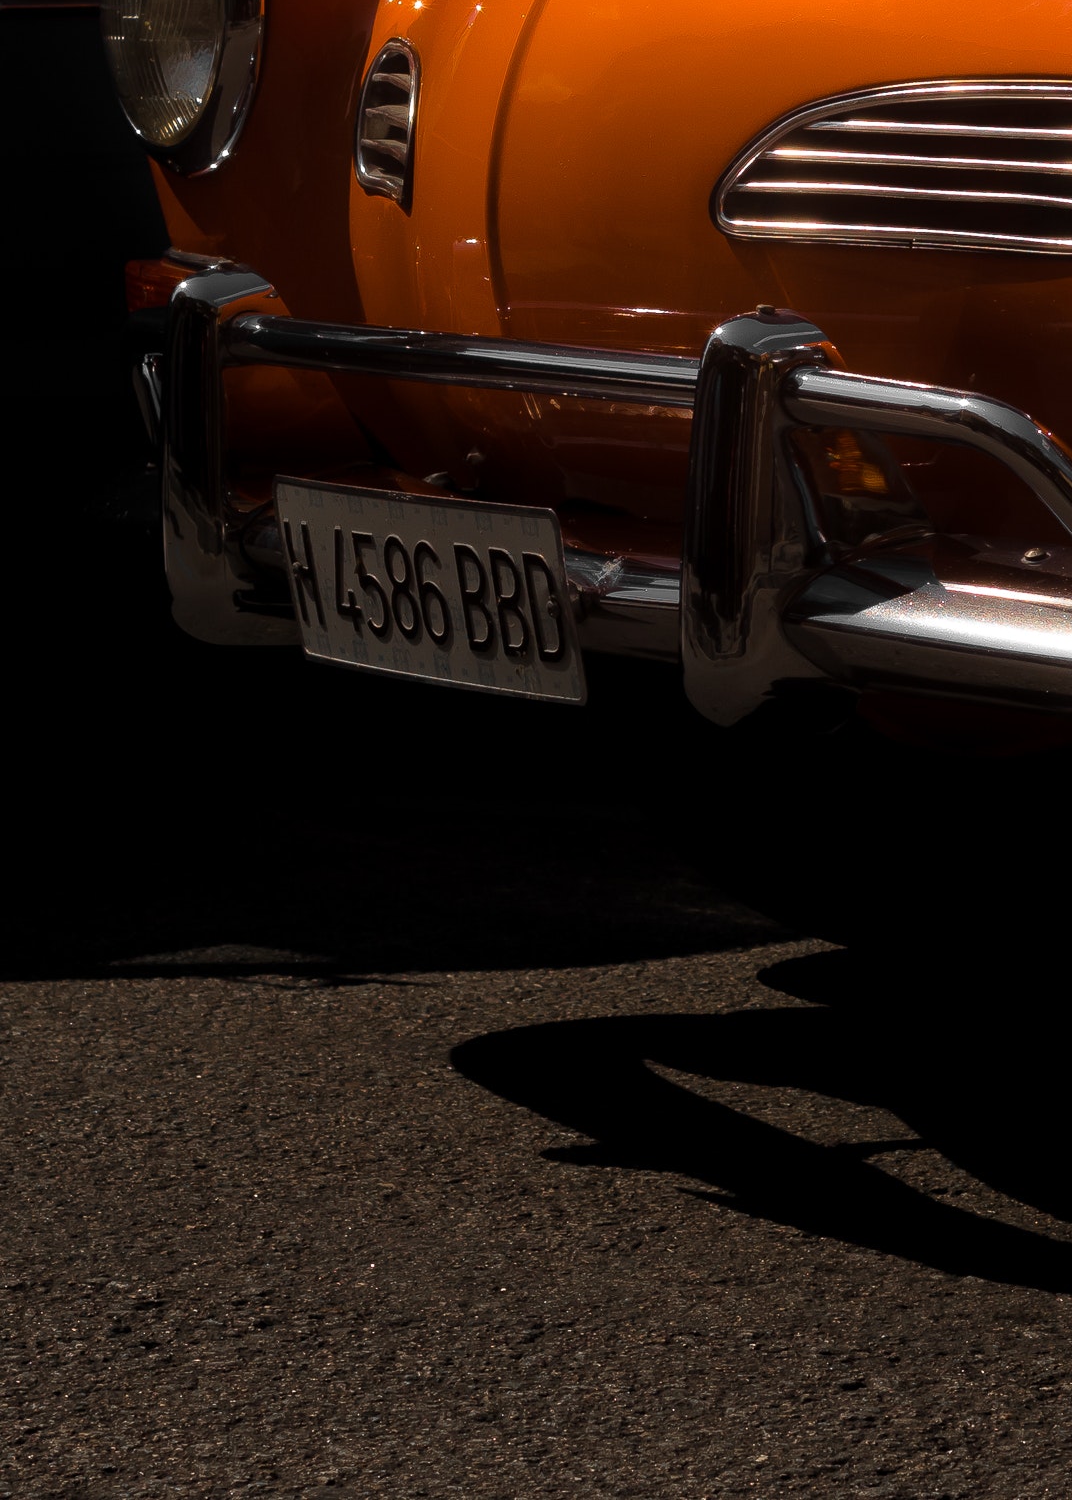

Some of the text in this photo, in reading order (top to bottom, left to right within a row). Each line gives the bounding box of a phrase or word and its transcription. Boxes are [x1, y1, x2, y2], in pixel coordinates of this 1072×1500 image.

[283, 516, 565, 663] H 4586 BBD
